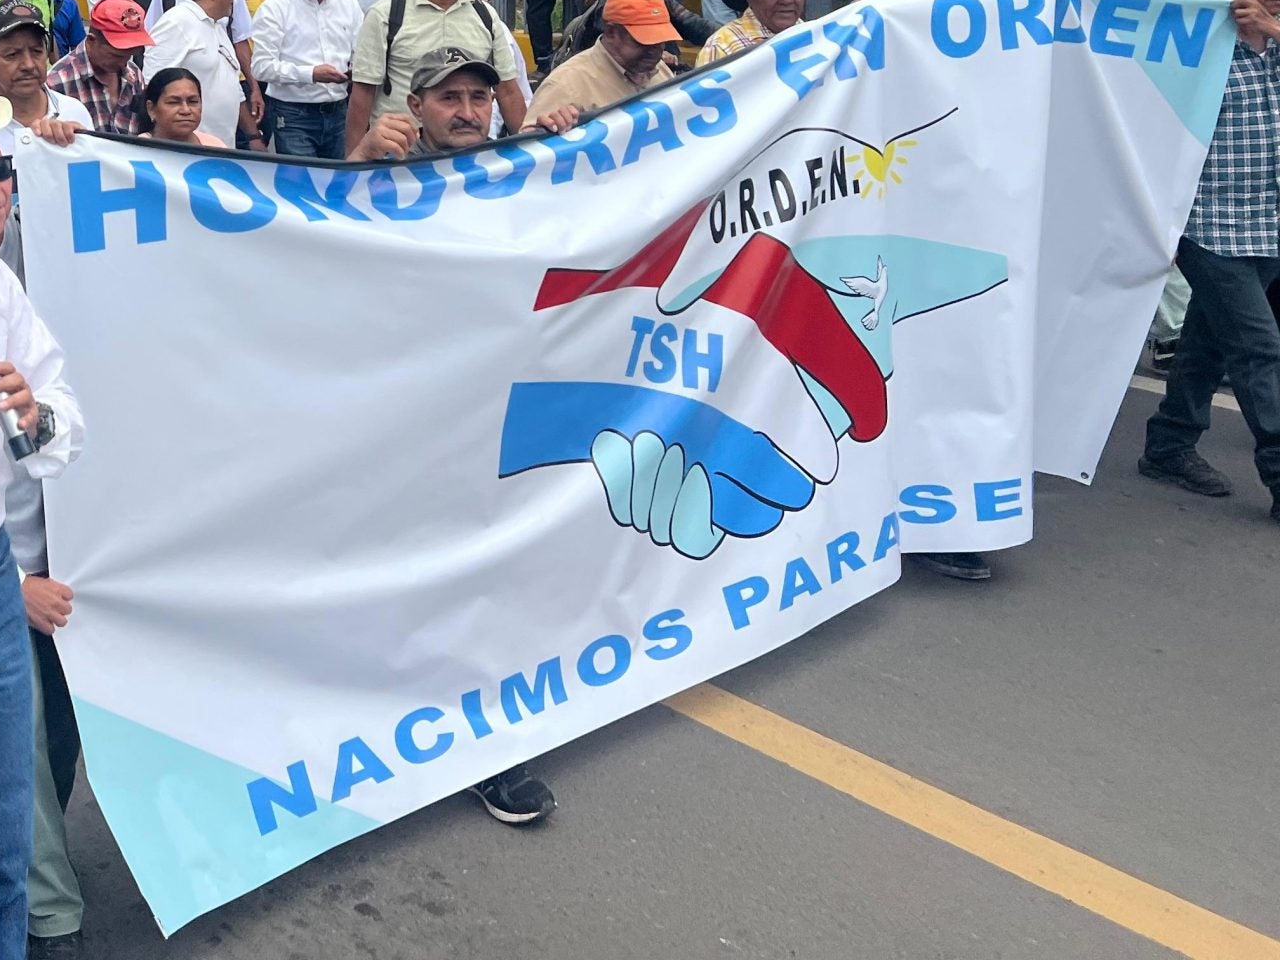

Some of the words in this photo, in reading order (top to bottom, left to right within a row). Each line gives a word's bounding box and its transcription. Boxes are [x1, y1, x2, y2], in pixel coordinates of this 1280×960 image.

[67, 80, 735, 253] HONDURAS
[771, 5, 886, 101] EN
[708, 145, 861, 245] O.R.D.E.N.
[626, 316, 723, 392] TSH
[246, 609, 692, 836] NACIMOS
[723, 513, 899, 629] PARA
[899, 479, 1022, 525] SE
